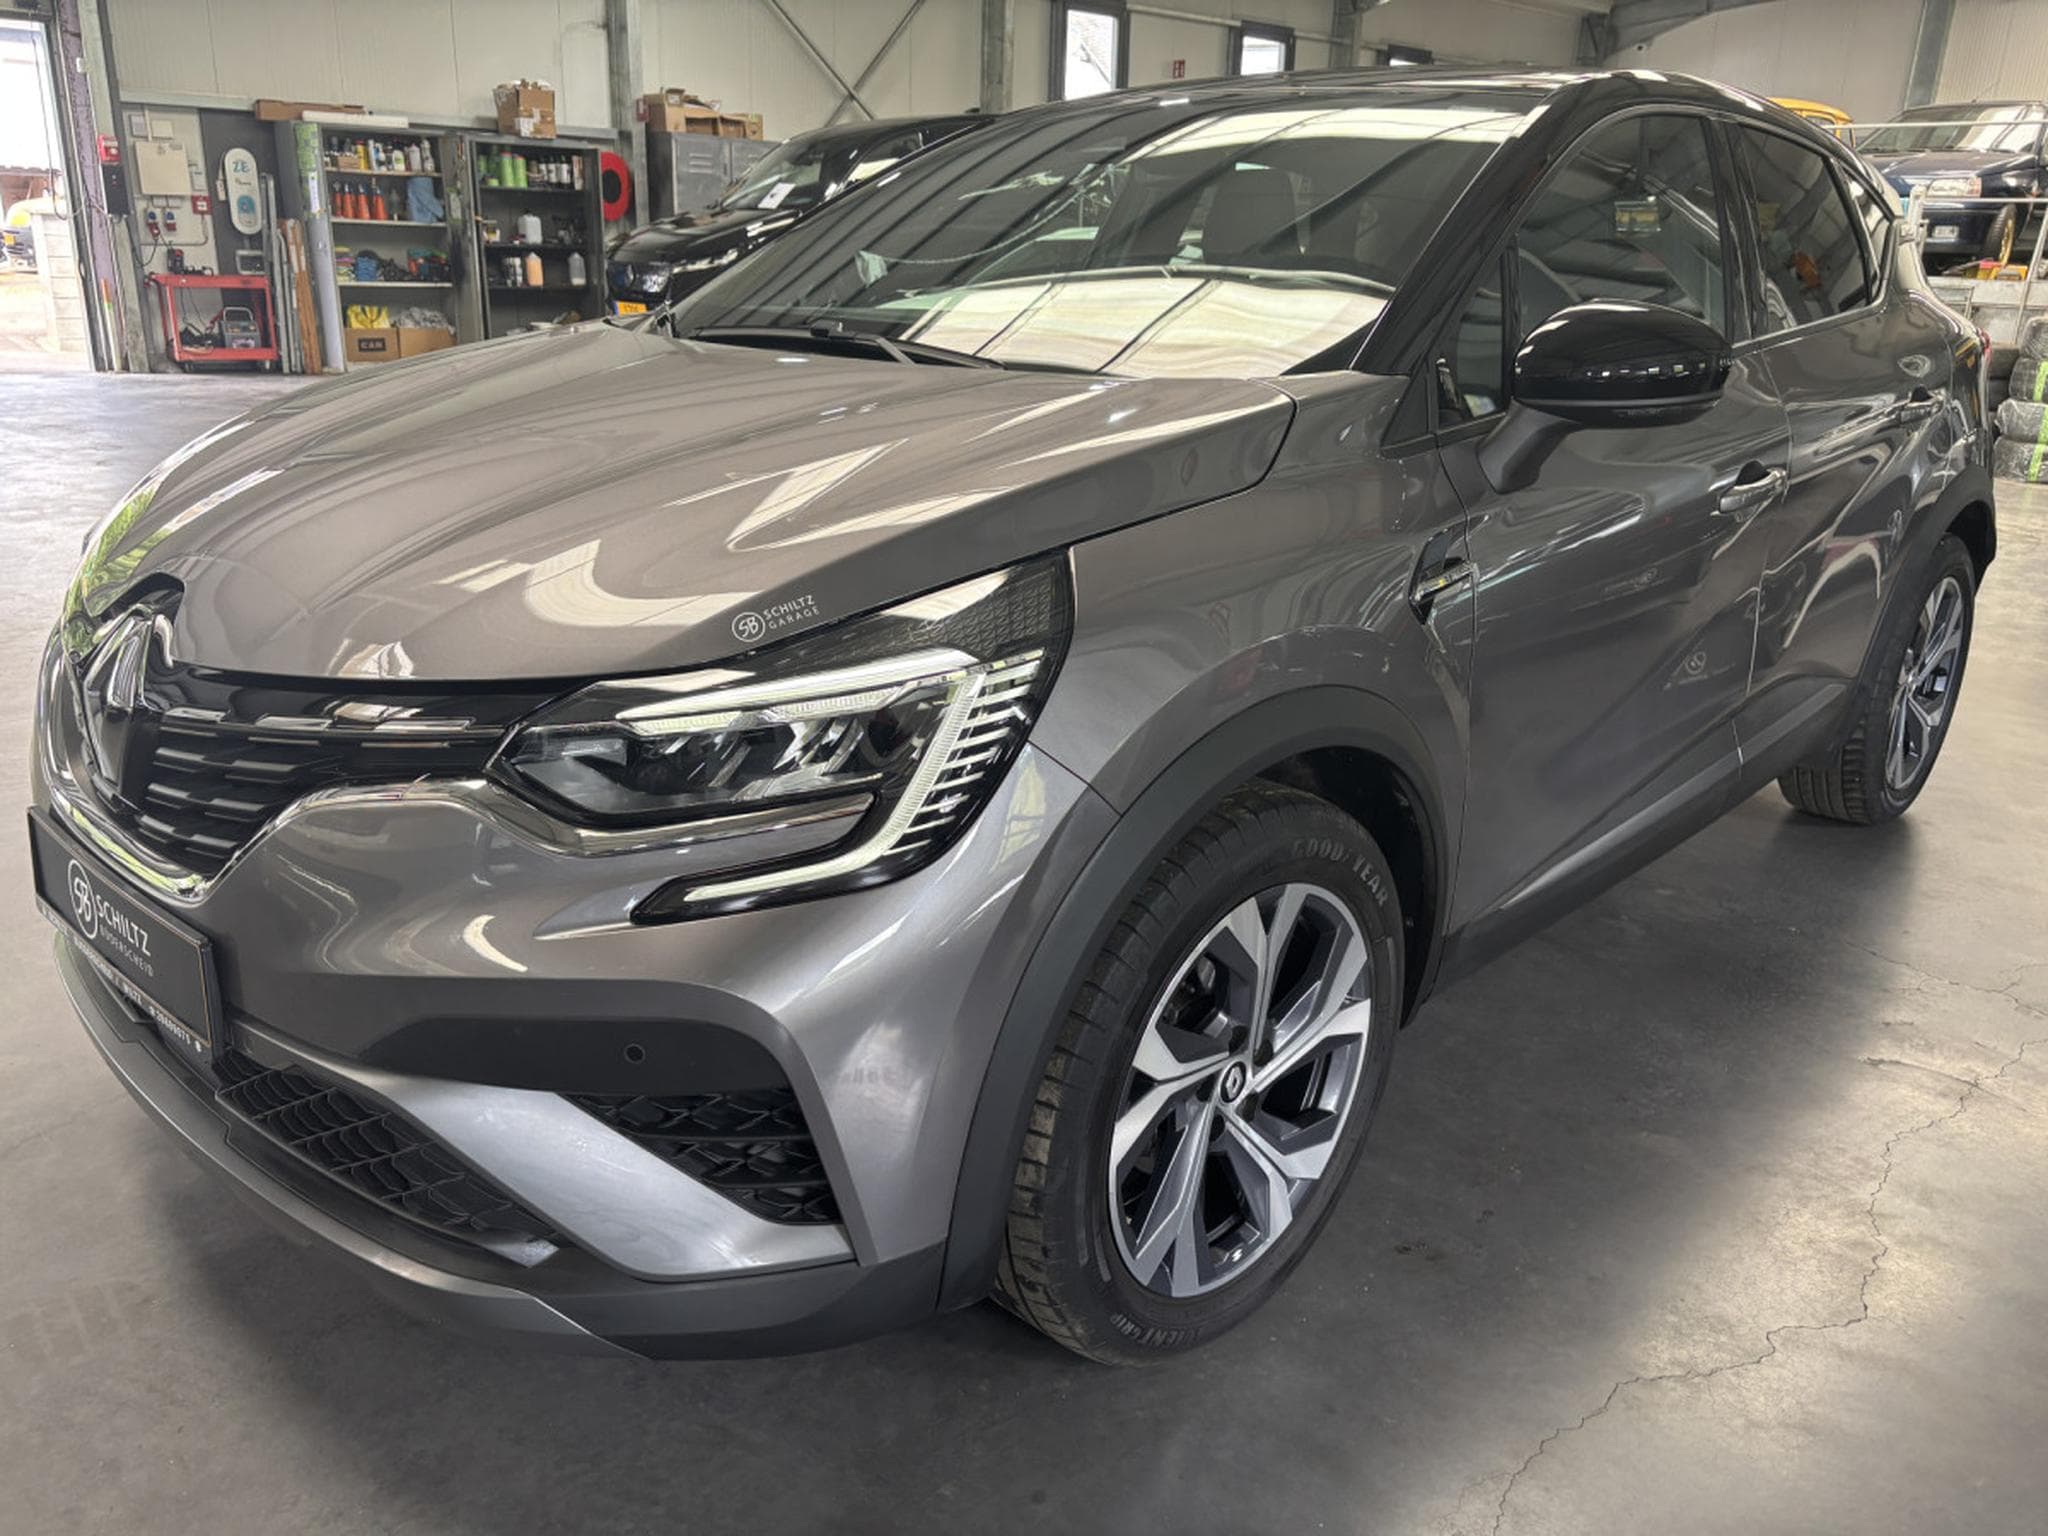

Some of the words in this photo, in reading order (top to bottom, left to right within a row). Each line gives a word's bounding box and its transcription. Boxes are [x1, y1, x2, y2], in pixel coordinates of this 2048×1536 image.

[763, 594, 815, 620] SCHILTZ
[768, 606, 820, 629] GARAGE
[95, 895, 151, 957] SCHILTZ
